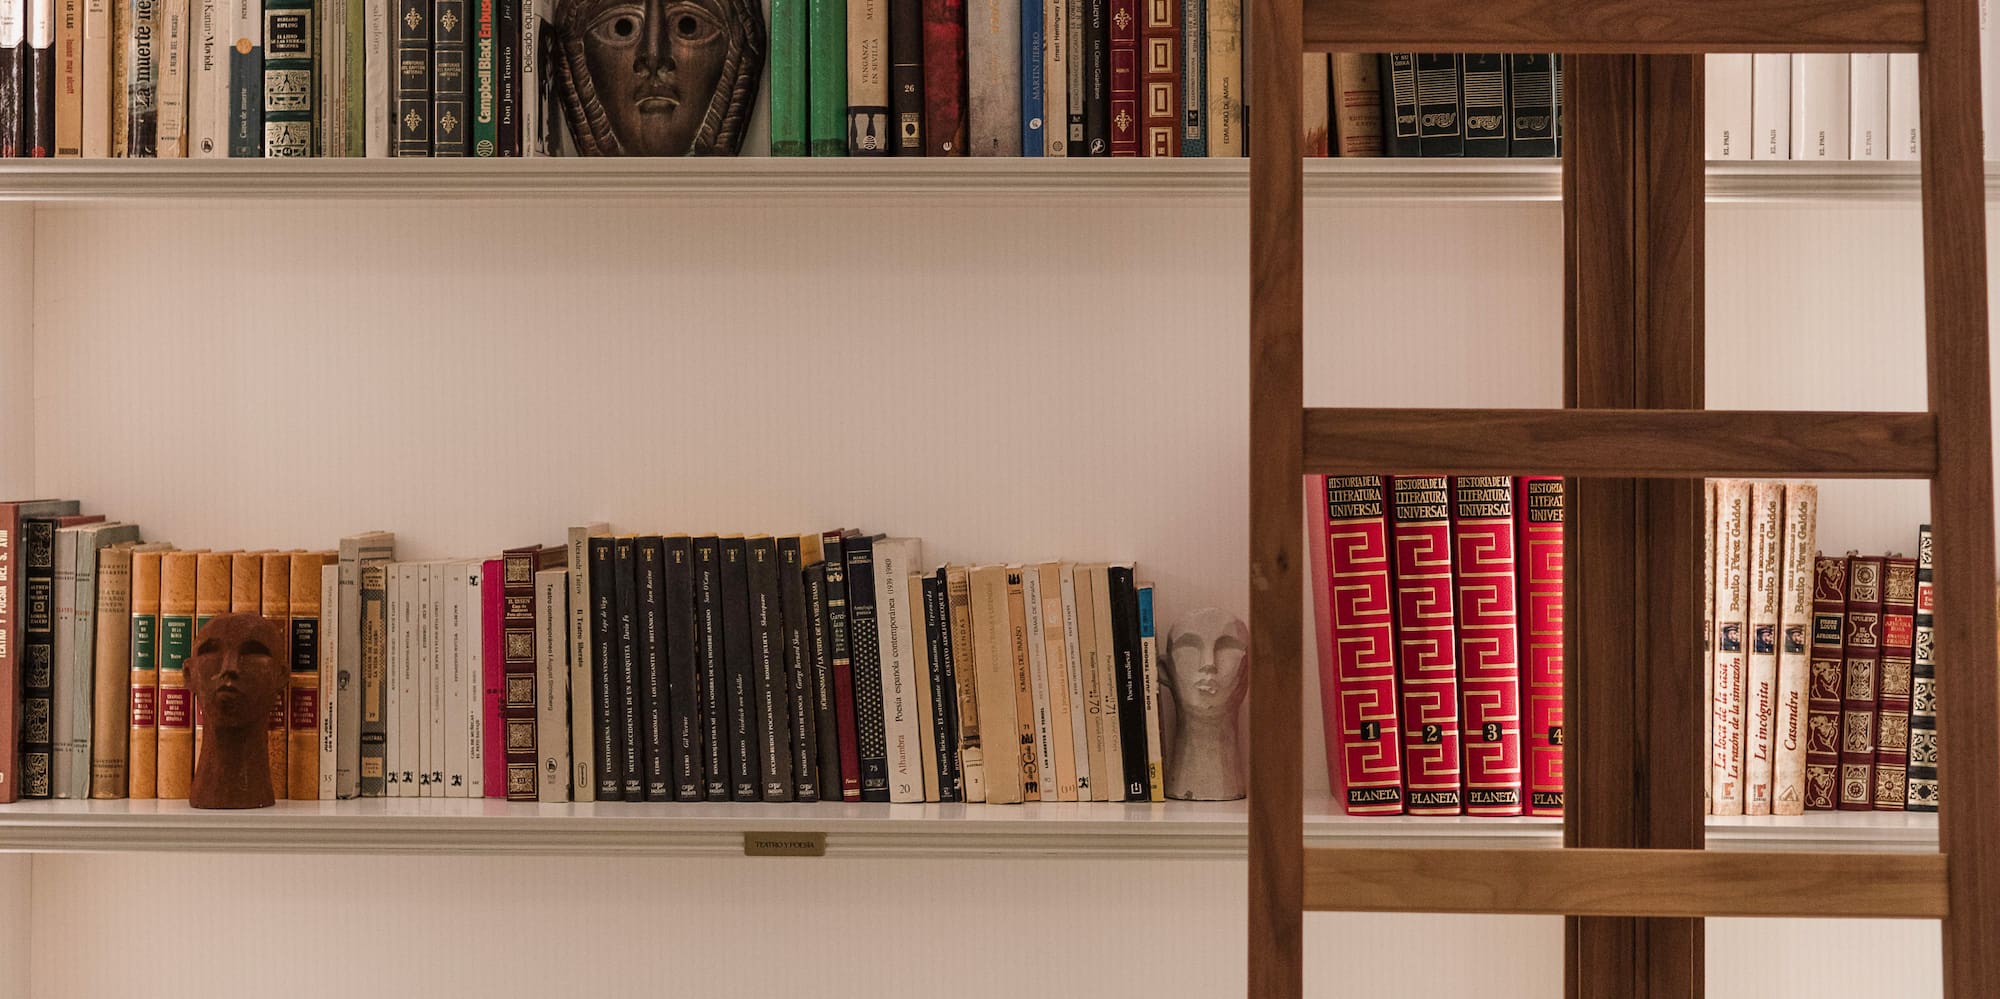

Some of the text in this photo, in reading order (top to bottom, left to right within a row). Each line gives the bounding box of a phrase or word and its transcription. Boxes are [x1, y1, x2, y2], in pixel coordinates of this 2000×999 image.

[66, 14, 75, 30] LILAS
[1053, 4, 1062, 62] Ernest Hemingway
[203, 3, 214, 72] Kanin Moviola
[1032, 31, 1041, 63] FIERRO
[523, 31, 533, 73] Delicado
[861, 38, 870, 84] VENGANZA
[871, 38, 879, 85] EN SEVILLA
[65, 60, 75, 96] may alcott
[134, 25, 151, 108] La muerte
[478, 23, 493, 124] Campbell Black En
[503, 46, 513, 125] Don Juan Tenorio
[904, 83, 915, 93] 26
[239, 87, 248, 139] Causa de muerte
[1222, 76, 1230, 145] EDMUNDO DE AMICIS
[1723, 147, 1730, 156] EL
[1770, 144, 1777, 155] EL
[1819, 146, 1825, 156] EL
[1865, 146, 1872, 156] EL
[1911, 144, 1917, 154] EL
[1328, 475, 1381, 489] HISTORIA DE LA
[1394, 477, 1448, 491] HISTORIA DE LA
[1457, 475, 1511, 488] HISTORIA DE LA
[1328, 488, 1382, 502] LITERATURA
[1394, 491, 1448, 505] LITERATURA
[1458, 488, 1511, 502] LITERATURA
[1330, 502, 1383, 517] UNIVERSAL
[1396, 504, 1448, 519] UNIVERSAL
[1458, 503, 1511, 517] UNIVERSAL
[575, 539, 583, 595] Alexandr Tairov
[1729, 498, 1741, 612] Benito Pérez Galdós
[1763, 500, 1777, 614] Benito Pérez Galdós
[1794, 501, 1808, 615] Benito Pérez Galdós
[645, 570, 655, 604] Jean Racine
[811, 581, 819, 601] DAMA
[600, 596, 609, 633] Lope de Vega
[759, 593, 768, 627] Shakespeare
[813, 601, 821, 617] VIEJA
[926, 590, 936, 627] Espronceda
[1031, 605, 1038, 615] DE
[705, 609, 713, 634] ARMADO
[814, 617, 821, 626] LA
[815, 626, 822, 636] DE
[576, 617, 585, 668] Teatro liberato
[940, 621, 952, 677] GUSTAVO ADOLFO
[959, 618, 969, 663] LEYENDAS
[601, 641, 609, 673] VENGANZA
[707, 659, 714, 669] UN
[792, 629, 803, 689] George Bernard Shaw
[1123, 650, 1133, 680] medieval
[707, 669, 715, 677] DE
[763, 659, 771, 680] ROMEO
[1017, 654, 1027, 693] SOMBRA DEL
[708, 677, 716, 701] SOMBRA
[736, 673, 744, 695] Schiller
[887, 598, 908, 775] Alhambra contemporánea
[931, 639, 944, 726] El estudiante de Salamanca
[623, 644, 636, 773] MUERTE ACCIDENTAL DE UN ANARQUISTA
[1088, 699, 1100, 715] 70
[1104, 703, 1117, 715] 71
[1714, 663, 1728, 770] La loca de la casa
[1727, 657, 1741, 780] La razón de la sinrazón
[681, 714, 689, 748] Gil Vicente
[738, 708, 746, 734] Friedrich
[1365, 722, 1376, 740] 1
[1426, 724, 1438, 742] 2
[1487, 723, 1498, 742] 3
[1754, 681, 1772, 762] La incógnita
[1783, 690, 1799, 752] Casandra
[1552, 728, 1564, 745] 4
[899, 783, 911, 794] 20
[1350, 788, 1400, 802] PLANETA
[1410, 792, 1459, 805] PLANETA
[1470, 790, 1518, 803] PLANETA
[754, 840, 784, 849] TEATRO
